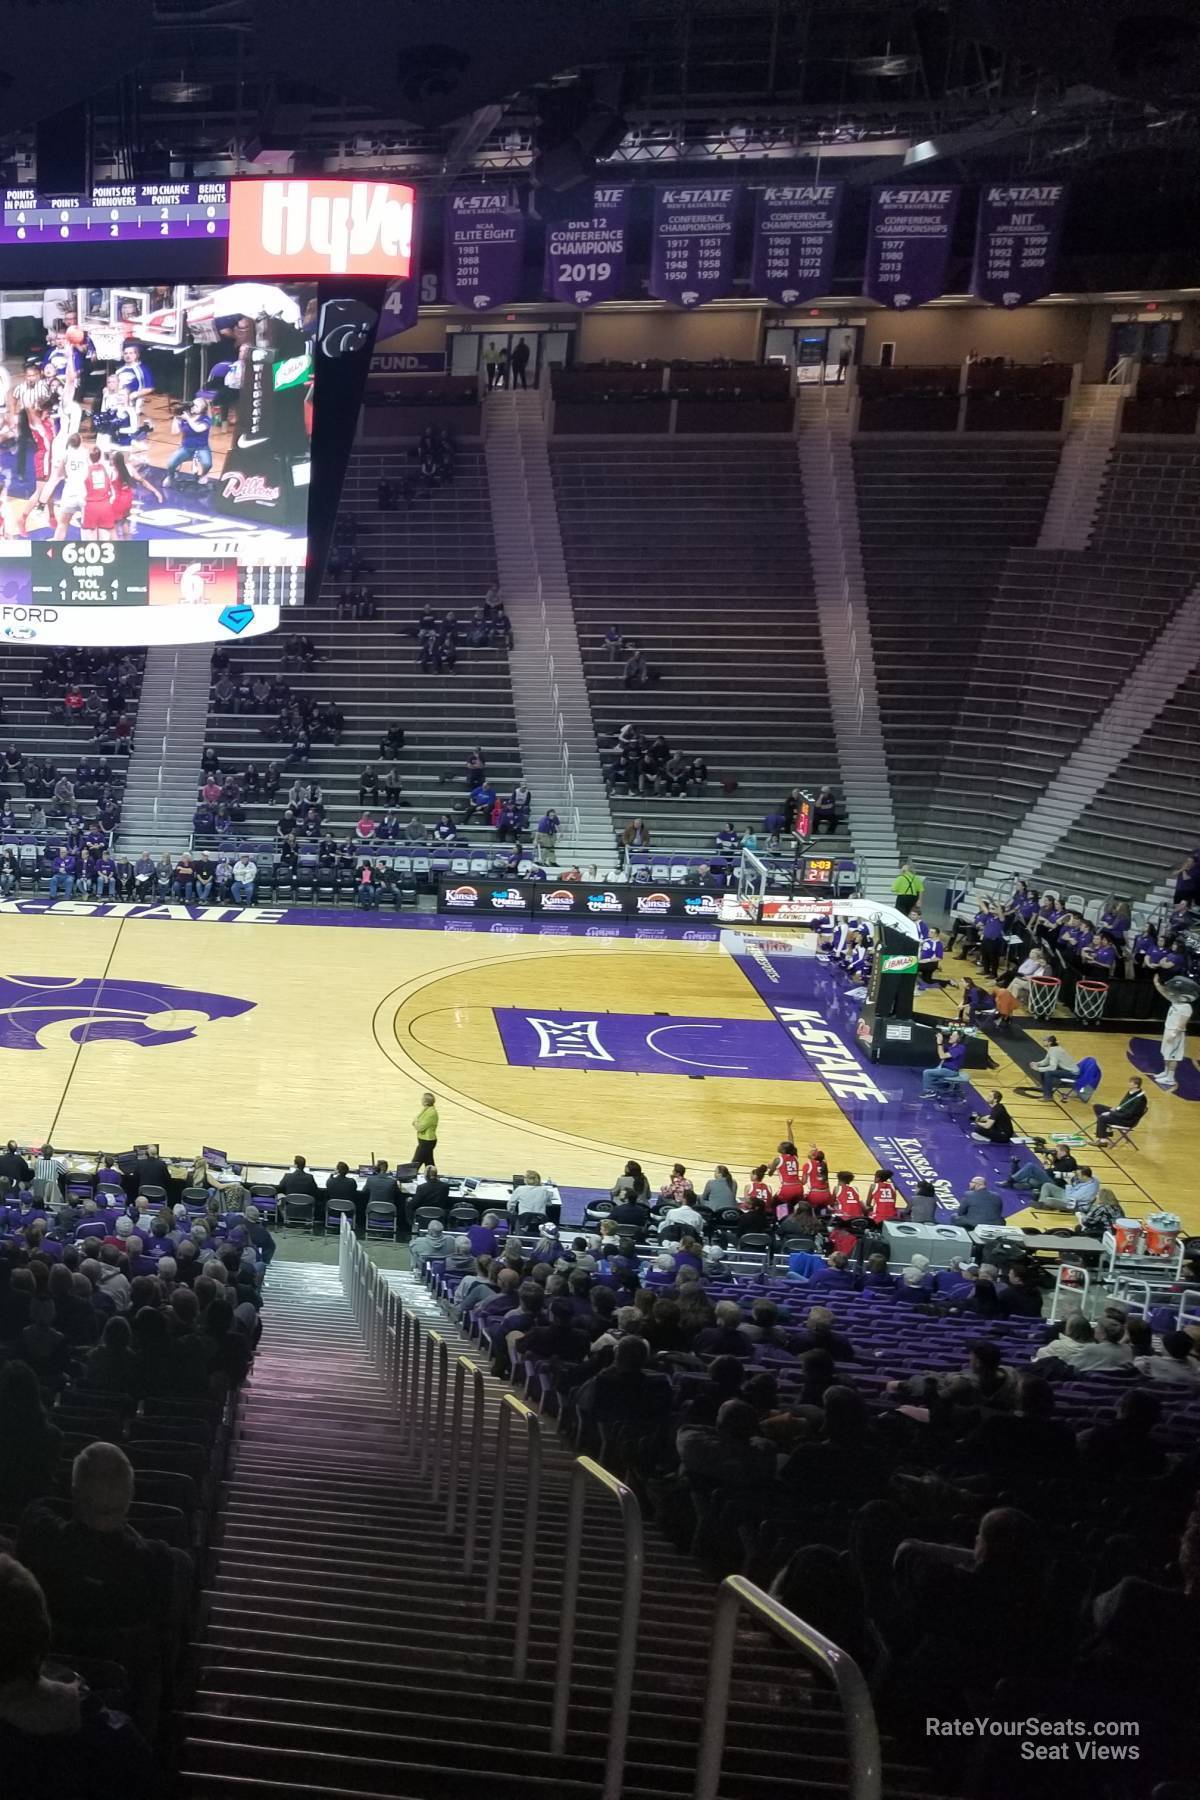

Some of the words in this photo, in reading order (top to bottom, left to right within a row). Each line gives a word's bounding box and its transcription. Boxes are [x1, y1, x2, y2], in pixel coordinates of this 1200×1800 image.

[93, 187, 120, 198] POINTS
[121, 186, 136, 197] OFF
[142, 186, 158, 196] 2ND
[159, 185, 189, 195] CHANCE
[198, 184, 225, 194] BENCH
[763, 186, 836, 201] K-STATE
[988, 186, 1063, 201] K-STATE
[7, 190, 34, 200] POINTS
[152, 195, 180, 205] POINTS
[198, 194, 226, 203] POINTS
[594, 190, 624, 201] ATE
[662, 189, 734, 203] K-STATE
[878, 190, 952, 204] K-STATE
[4, 200, 13, 209] IN
[14, 199, 37, 209] PAINT
[51, 199, 79, 208] POINTS
[453, 195, 507, 210] K-STAT
[17, 212, 26, 223] 4
[60, 211, 69, 222] 0
[110, 209, 119, 221] 0
[160, 208, 169, 219] 2
[206, 206, 215, 217] 0
[668, 214, 724, 223] CONFERENCE
[770, 212, 827, 221] CONFERENCE
[884, 215, 941, 224] CONFERENCE
[1011, 213, 1036, 225] NIT
[60, 226, 69, 237] 0
[110, 225, 119, 236] 2
[160, 223, 169, 235] 2
[206, 221, 215, 233] 0
[568, 221, 589, 230] BIG
[592, 218, 607, 229] 12
[659, 222, 732, 233] CHAMPIONSHIPS
[761, 220, 833, 230] CHAMPIONSHIPS
[875, 224, 947, 233] CHAMPIONSHIPS
[454, 231, 482, 241] ELITE
[483, 229, 515, 239] EIGHT
[551, 230, 623, 241] CONFERENCE
[666, 239, 688, 248] 1917
[699, 238, 720, 247] 1951
[882, 240, 905, 249] 1977
[458, 246, 479, 255] 1981
[550, 242, 623, 255] CHAMPIONS
[768, 247, 790, 256] 1961
[800, 247, 823, 255] 1970
[1022, 247, 1046, 256] 2007
[666, 250, 689, 259] 1919
[698, 249, 721, 258] 1956
[458, 256, 480, 265] 1988
[665, 261, 688, 269] 1948
[698, 260, 720, 269] 1958
[767, 258, 790, 267] 1963
[799, 258, 821, 266] 1972
[456, 267, 479, 276] 2010
[557, 262, 611, 281] 2019
[879, 262, 902, 271] 2013
[664, 271, 687, 280] 1950
[697, 270, 720, 279] 1959
[767, 269, 789, 278] 1964
[798, 269, 821, 278] 1973
[878, 273, 901, 282] 2019
[456, 277, 479, 286] 2018
[370, 356, 418, 371] FUND
[62, 542, 115, 564] 6:03
[59, 579, 67, 589] 4
[78, 579, 100, 589] TOL
[111, 579, 119, 589] 4
[60, 591, 66, 600] 1
[71, 591, 107, 600] FOULS
[111, 591, 118, 600] 1
[3, 606, 58, 623] FORD
[810, 861, 832, 870] 6:03
[810, 870, 825, 880] 21
[445, 889, 478, 901] Kansas
[540, 893, 575, 905] Kansas
[636, 896, 671, 909] Kansas
[790, 904, 830, 913] StateFarm
[774, 1005, 889, 1105] K-STATE
[847, 1191, 855, 1200] 3
